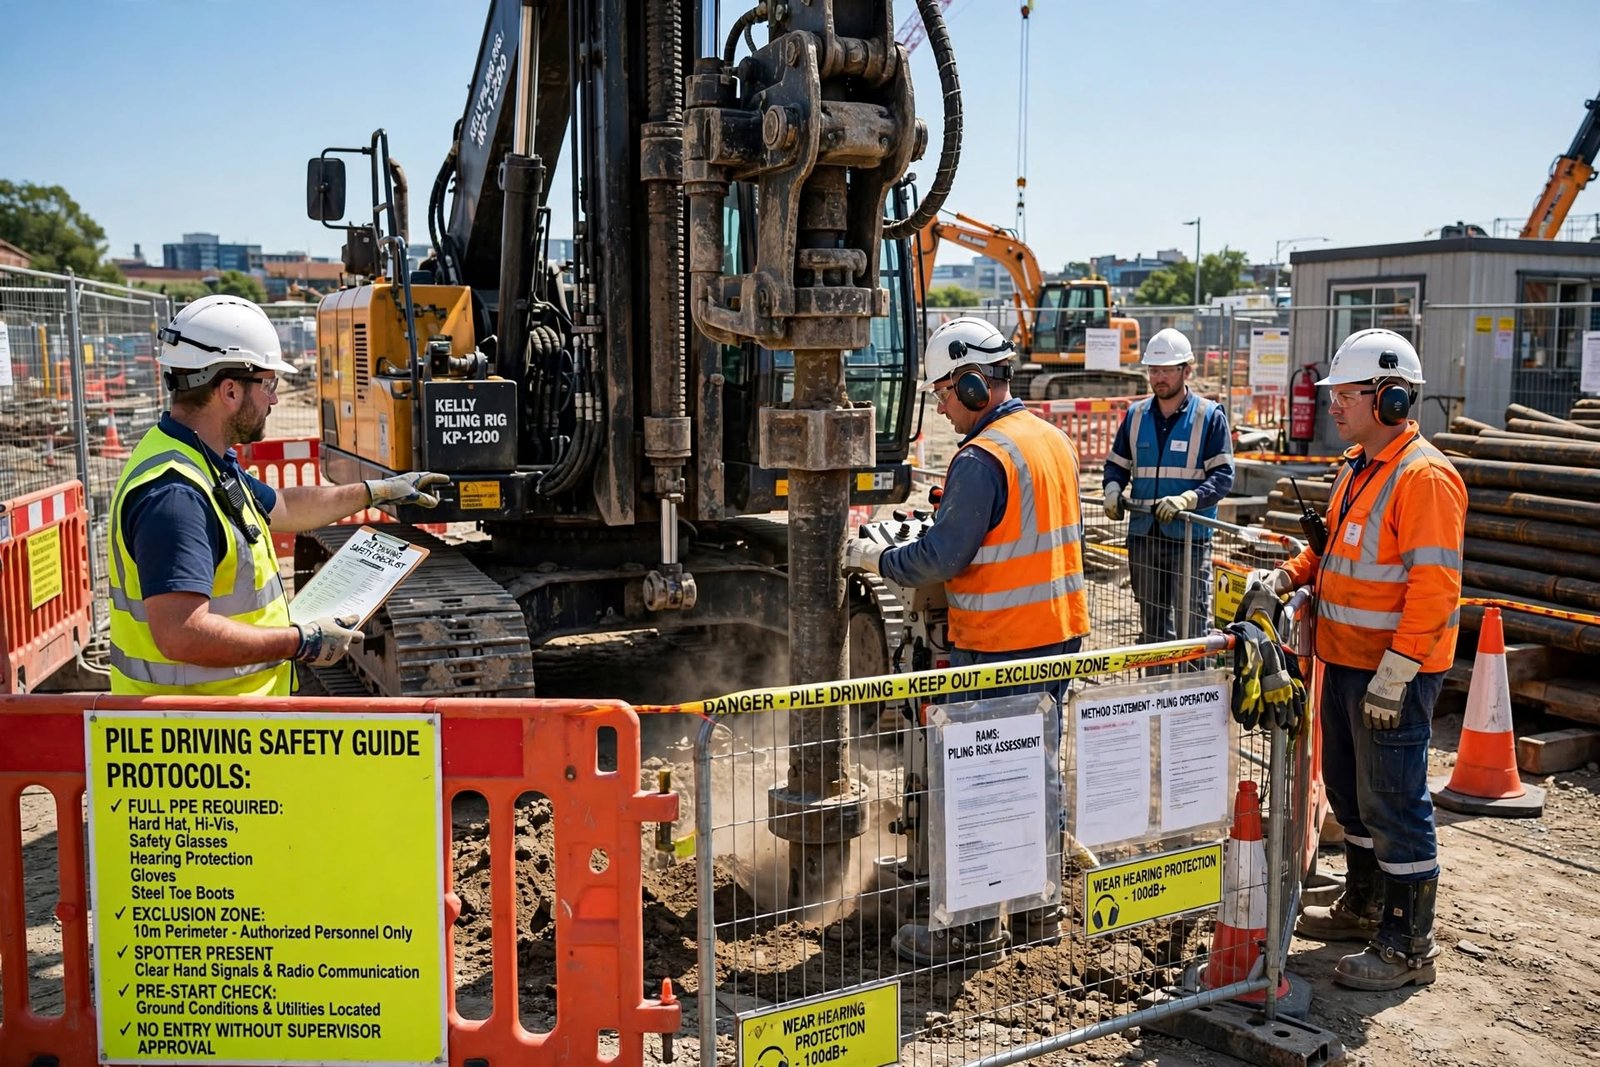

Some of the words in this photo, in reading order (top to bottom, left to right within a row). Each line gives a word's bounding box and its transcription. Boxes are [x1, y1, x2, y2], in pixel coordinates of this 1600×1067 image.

[435, 399, 476, 412] KELLY
[435, 415, 480, 428] PILING
[484, 414, 507, 426] RIG
[442, 430, 500, 444] KP-1200
[703, 693, 774, 715] DANGER
[790, 688, 825, 706] PILE
[830, 680, 893, 703] DRIVING
[909, 674, 947, 694] KEEP
[951, 669, 979, 690] OUT
[996, 660, 1071, 685] EXCLUSION
[1074, 656, 1111, 674] ZONE
[1112, 700, 1151, 716] STATEMENT
[1156, 696, 1178, 709] PILING
[106, 728, 153, 753] PILE
[162, 728, 251, 754] DRIVING
[260, 729, 343, 755] SAFETY
[353, 730, 419, 756] GUIDE
[975, 728, 1000, 742] RAMS:
[948, 745, 974, 760] PILING
[976, 743, 993, 756] RISK
[994, 735, 1041, 754] ASSESSMENT
[107, 763, 250, 789] PROTOCOLS:
[129, 799, 165, 813] FULL
[170, 799, 198, 813] PPE
[203, 800, 283, 814] REQUIRED:
[129, 816, 160, 830] Hard
[165, 817, 190, 833] Hat,
[195, 817, 238, 833] Hi-Vis,
[130, 834, 171, 850] Safety
[176, 834, 227, 848] Glasses
[131, 852, 181, 868] Hearing
[186, 852, 252, 865] Protection
[131, 869, 176, 882] Gloves
[1093, 875, 1121, 893] WEAR
[1123, 866, 1162, 887] HEARING
[1164, 854, 1217, 878] PROTECTION
[132, 885, 164, 899] Steel
[169, 886, 191, 899] Toe
[197, 886, 234, 900] Boots
[1131, 883, 1167, 902] 100dB+
[133, 907, 215, 921] EXCLUSION
[221, 908, 264, 921] ZONE:
[134, 924, 161, 938] 10m
[166, 924, 228, 938] Perimeter
[240, 925, 310, 939] Authorized
[315, 926, 378, 939] Personnel
[383, 926, 412, 943] Only
[135, 946, 201, 960] SPOTTER
[207, 946, 273, 960] PRESENT
[135, 963, 169, 976] Clear
[174, 963, 206, 977] Hand
[211, 963, 258, 980] Signals
[263, 964, 272, 977] &
[277, 964, 314, 977] Radio
[318, 965, 419, 978] Communication
[136, 984, 217, 999] PRE-START
[222, 985, 276, 999] CHECK:
[137, 1001, 184, 1014] Ground
[189, 1001, 258, 1015] Conditions
[263, 1002, 272, 1015] &
[277, 1002, 324, 1016] Utilities
[330, 1003, 380, 1016] Located
[783, 1014, 816, 1036] WEAR
[817, 1002, 866, 1026] HEARING
[137, 1023, 159, 1037] NO
[164, 1023, 211, 1037] ENTRY
[216, 1023, 283, 1038] WITHOUT
[288, 1023, 381, 1038] SUPERVISOR
[795, 1019, 866, 1051] PROTECTION
[138, 1040, 216, 1055] APPROVAL
[804, 1044, 848, 1067] 100dB+
